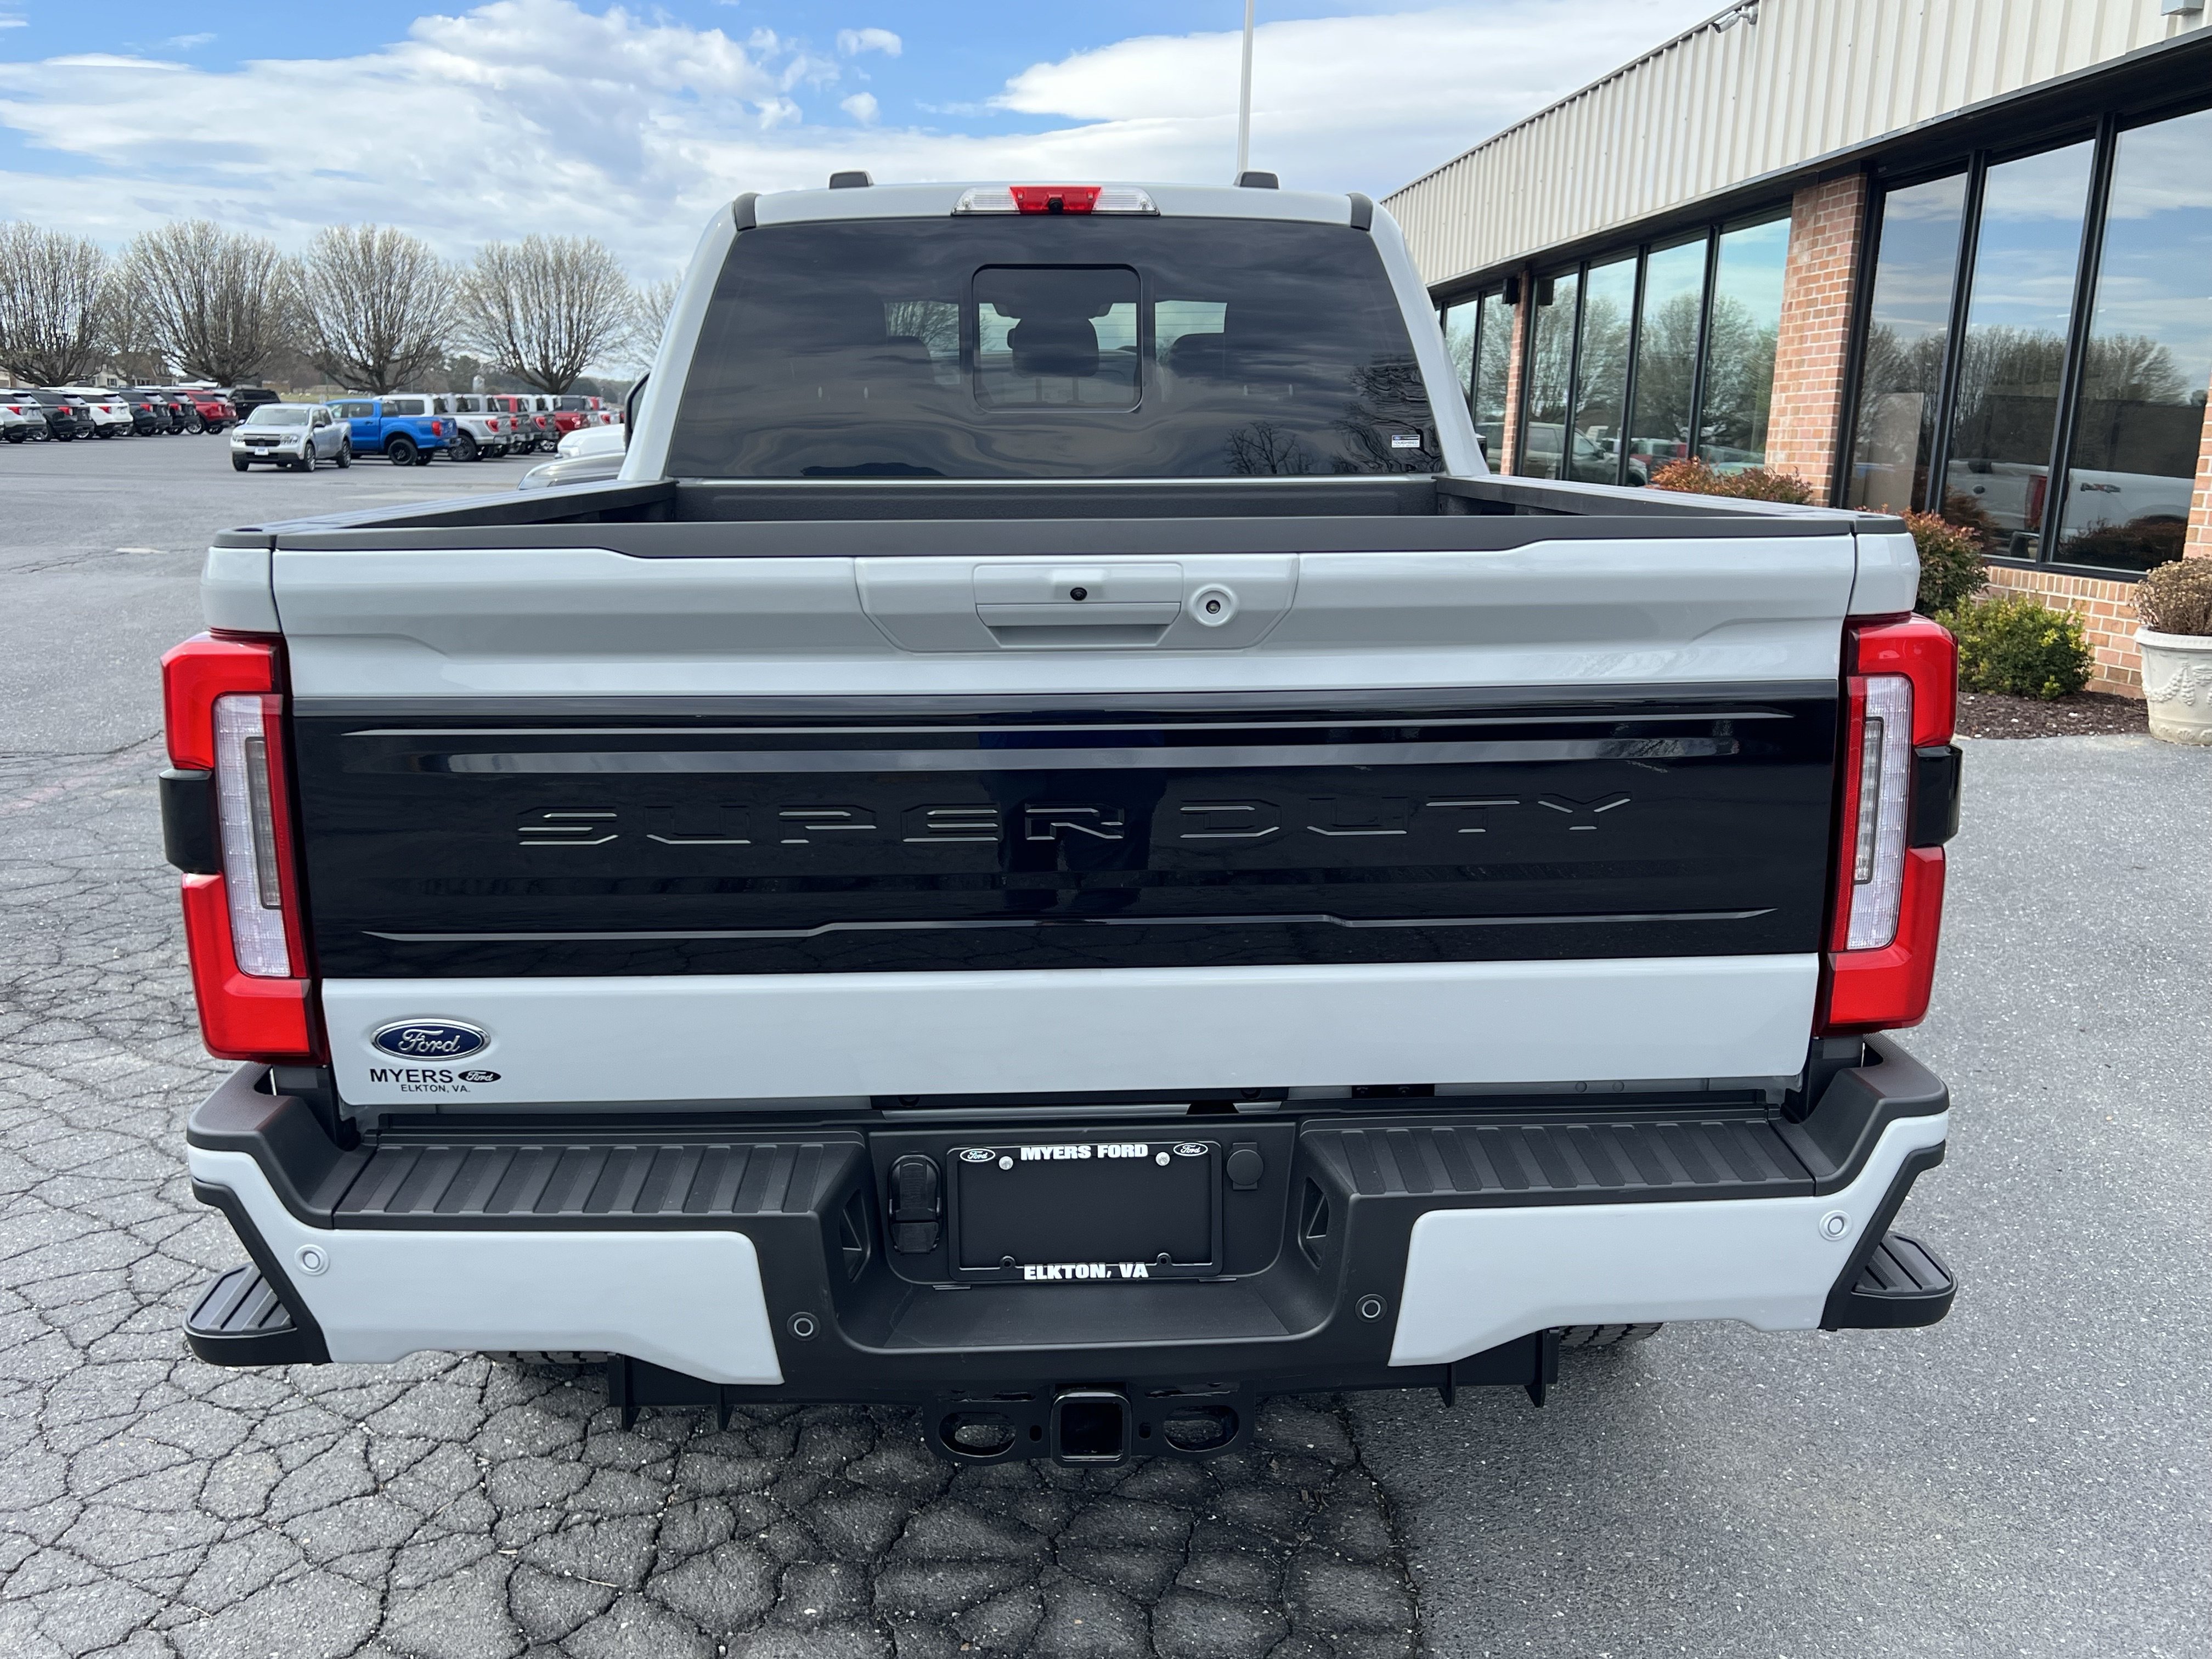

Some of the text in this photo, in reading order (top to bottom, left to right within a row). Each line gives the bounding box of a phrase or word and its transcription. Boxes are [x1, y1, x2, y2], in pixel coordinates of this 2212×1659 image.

[517, 792, 1632, 846] SUPER DUTY
[398, 1029, 460, 1052] Ford
[370, 1069, 494, 1083] MYERS Ford
[401, 1084, 449, 1093] ELKTON,
[967, 1151, 988, 1159] Ford
[1020, 1144, 1148, 1160] MYERS FORD
[1181, 1144, 1200, 1153] Ford
[1024, 1262, 1149, 1280] ELKTON, VA
